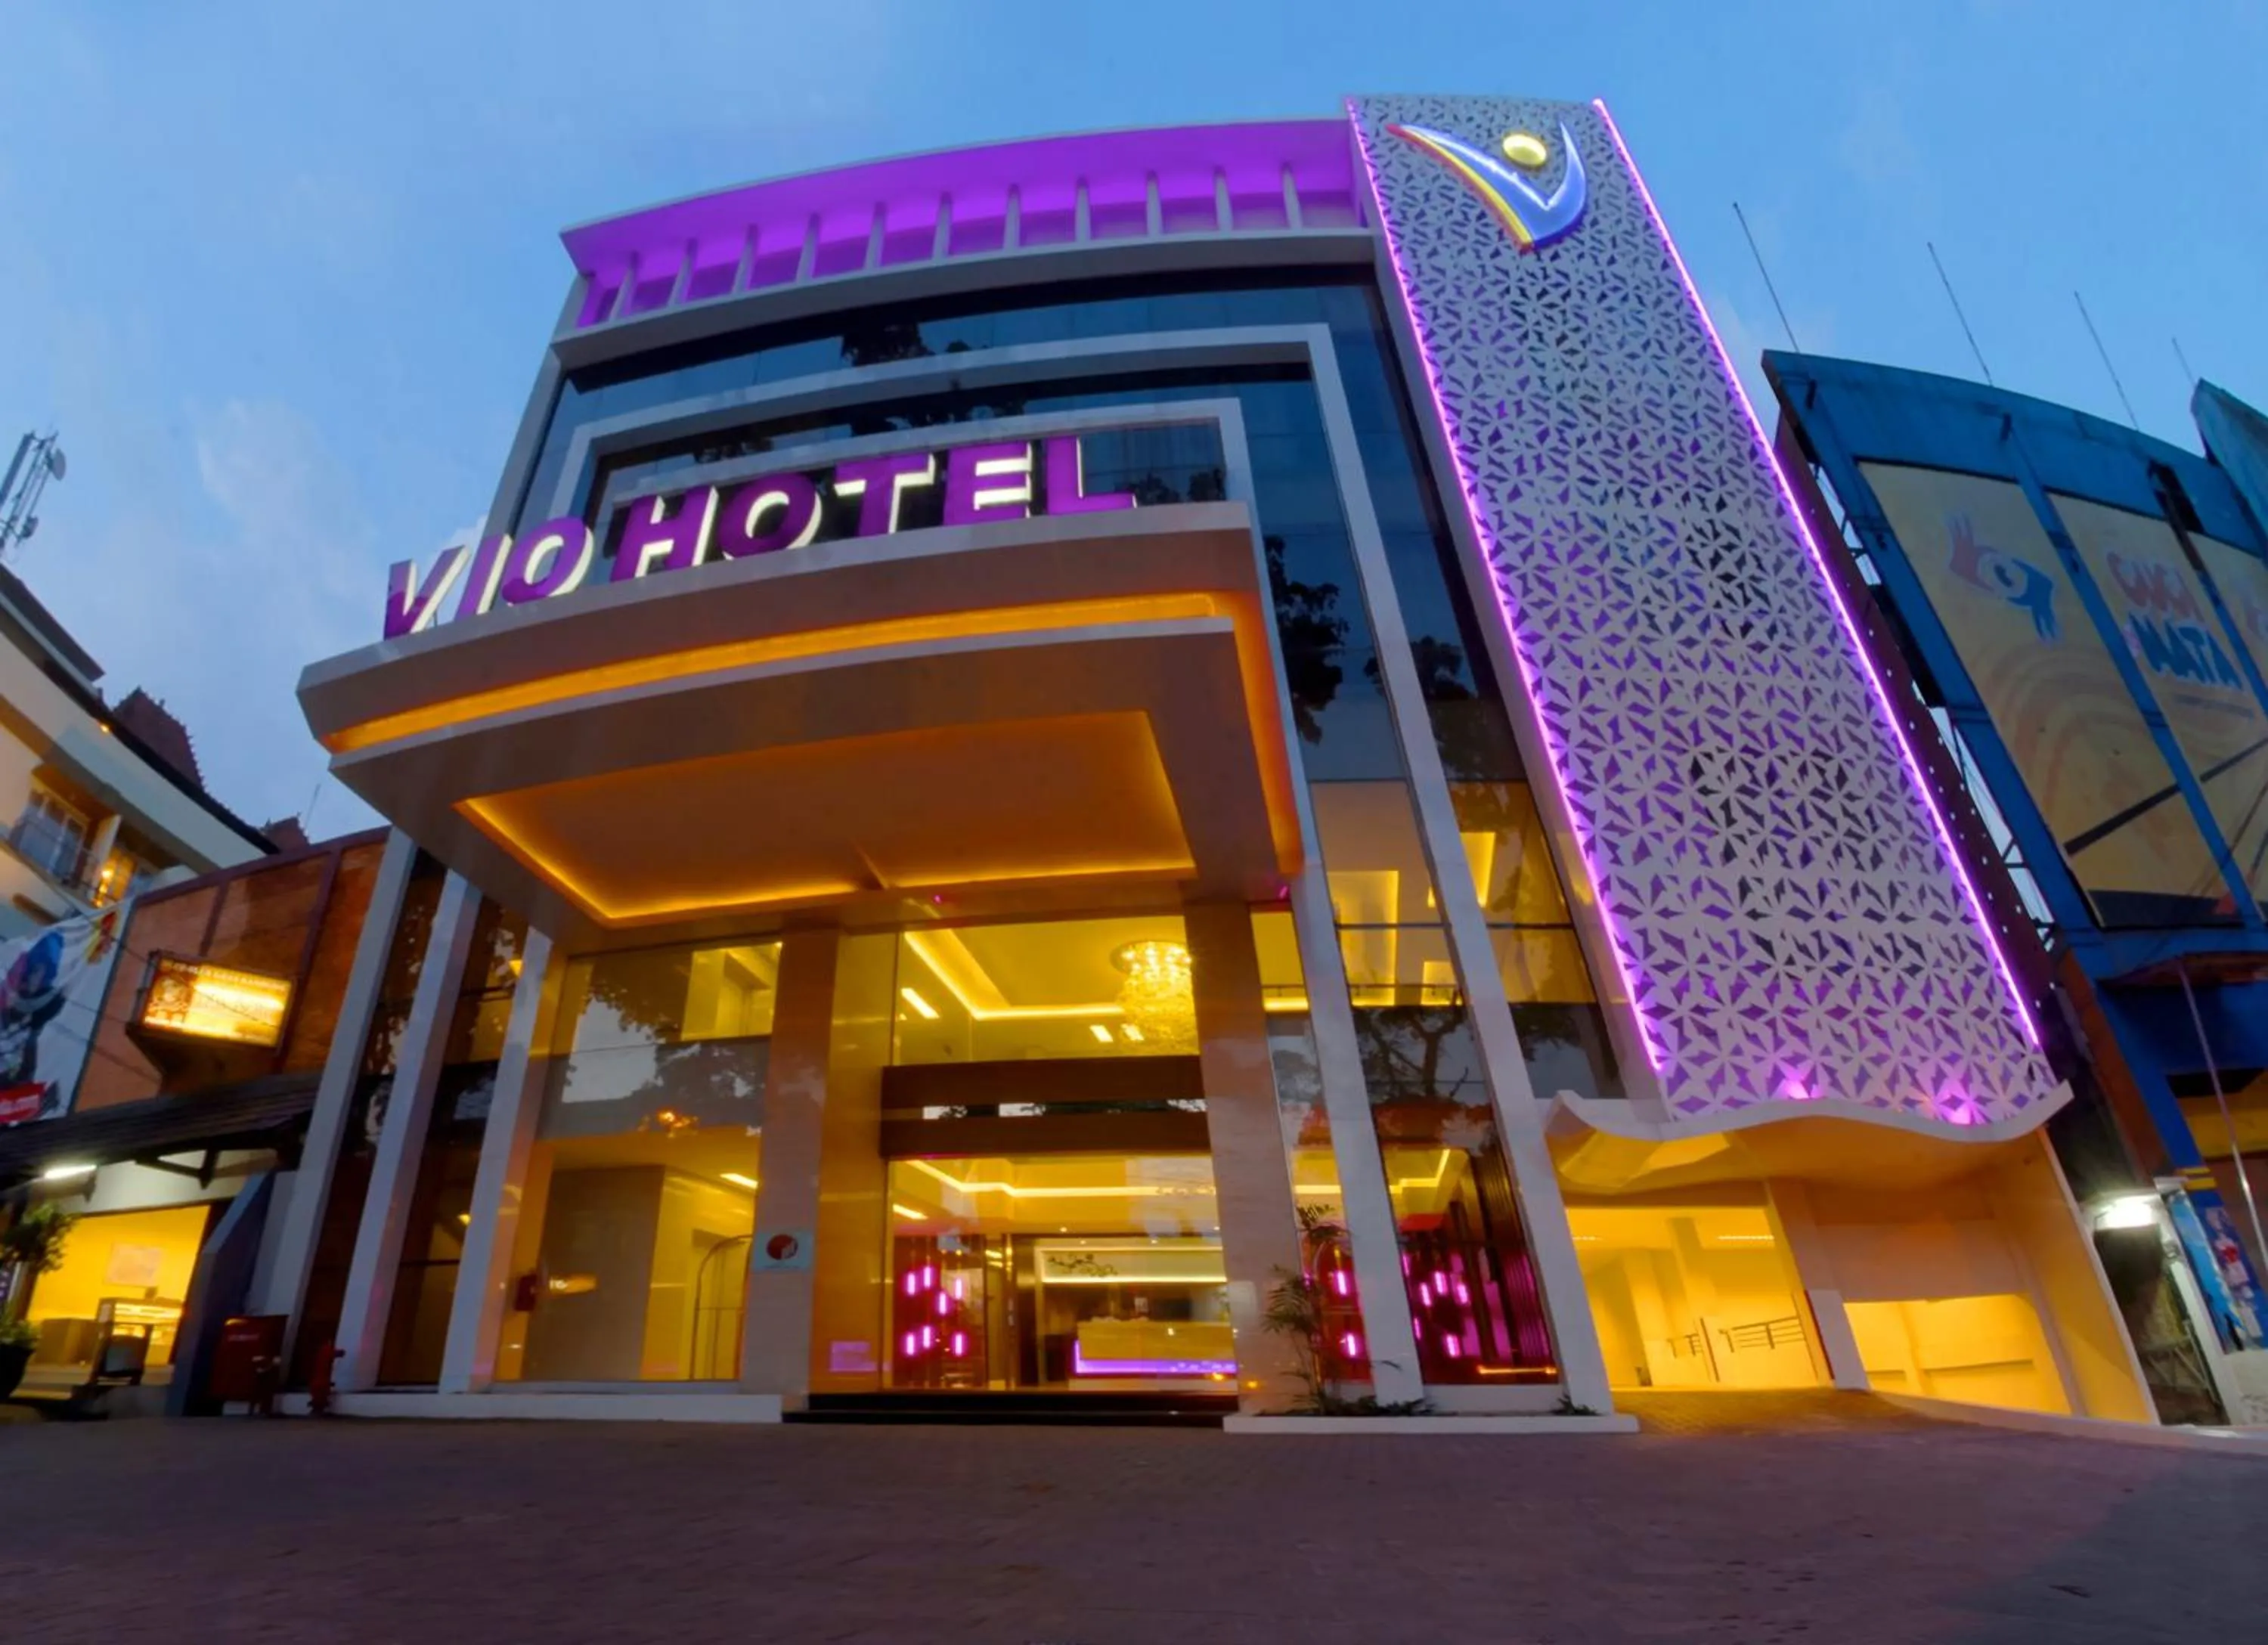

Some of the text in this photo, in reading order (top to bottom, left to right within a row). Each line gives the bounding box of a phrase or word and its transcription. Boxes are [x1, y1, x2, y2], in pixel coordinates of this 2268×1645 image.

[383, 434, 1137, 640] VIO HOTEL
[2128, 612, 2243, 689] MATA
